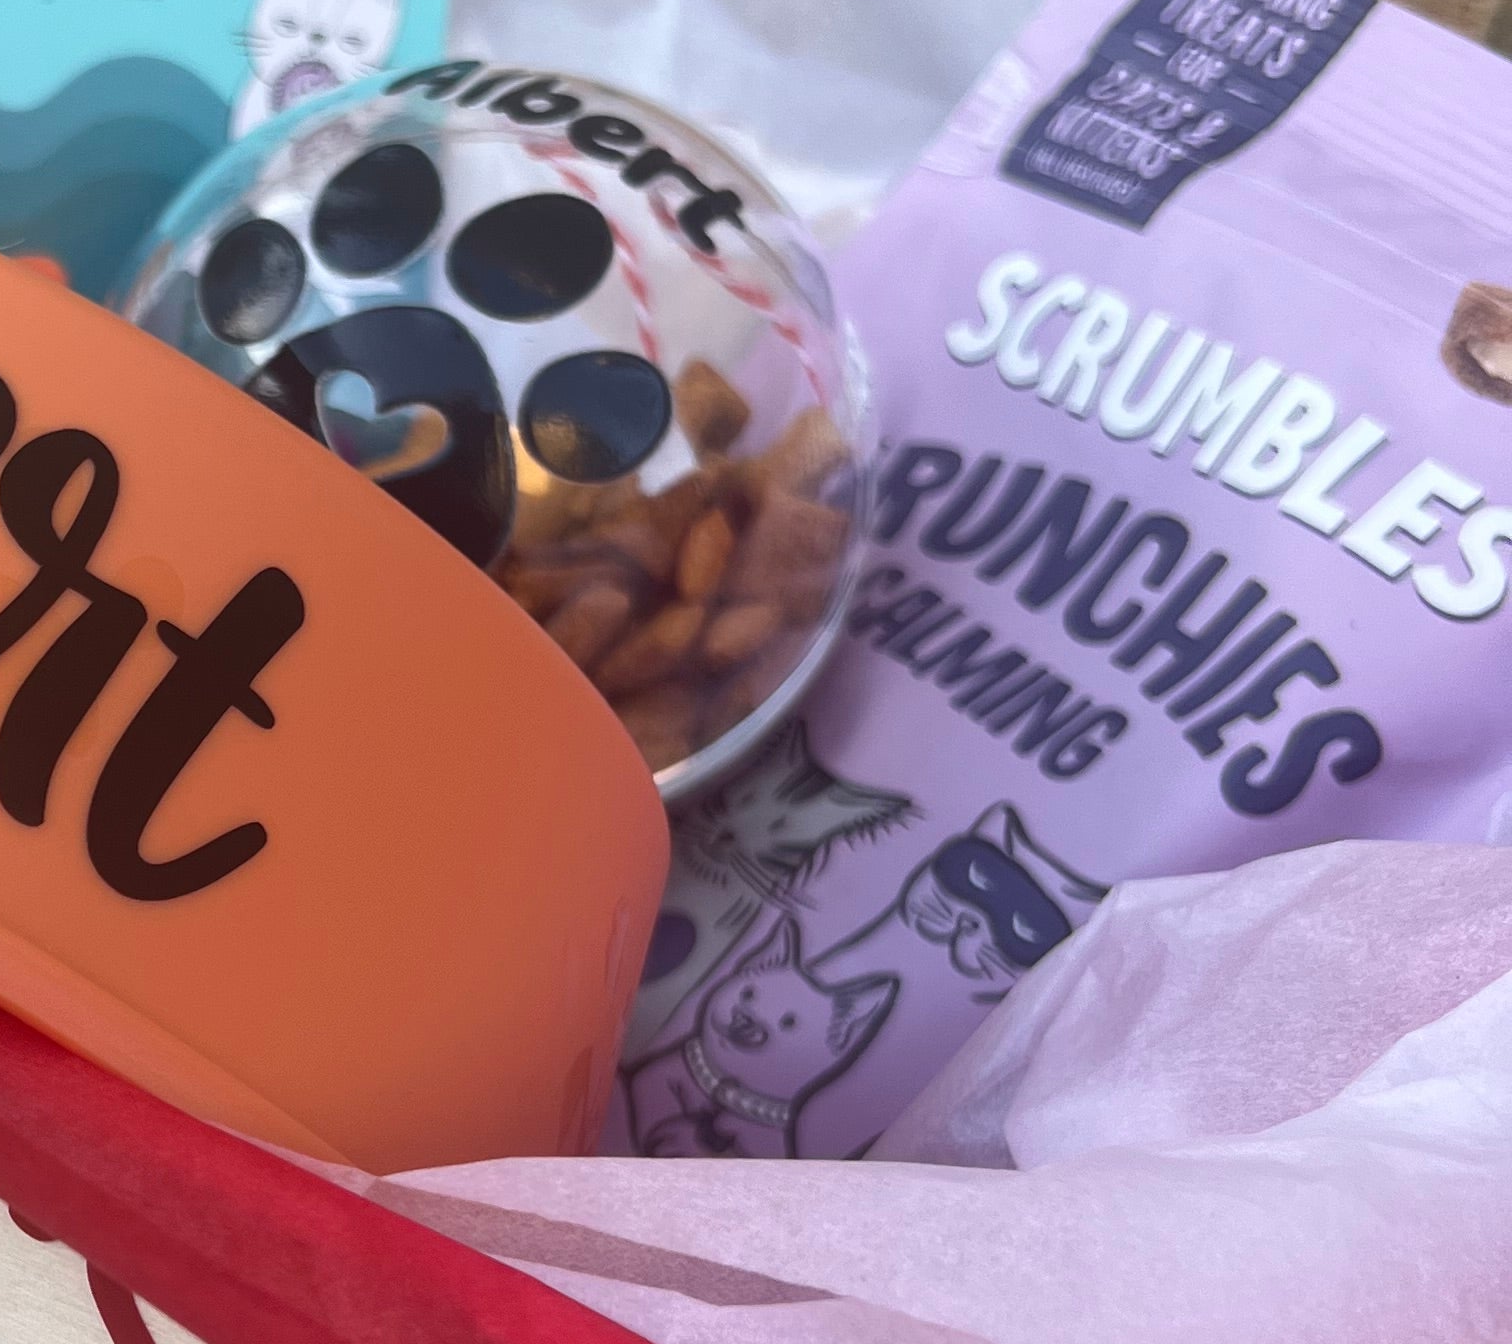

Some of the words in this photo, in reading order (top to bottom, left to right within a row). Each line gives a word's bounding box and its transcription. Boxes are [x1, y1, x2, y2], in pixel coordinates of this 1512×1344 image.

[382, 60, 746, 254] Albert
[1087, 59, 1198, 130] CATS
[1165, 41, 1230, 93] FOR
[944, 250, 1512, 621] SCRUMBLES
[847, 567, 1129, 781] CALMING
[872, 441, 1384, 816] RUNCHIES
